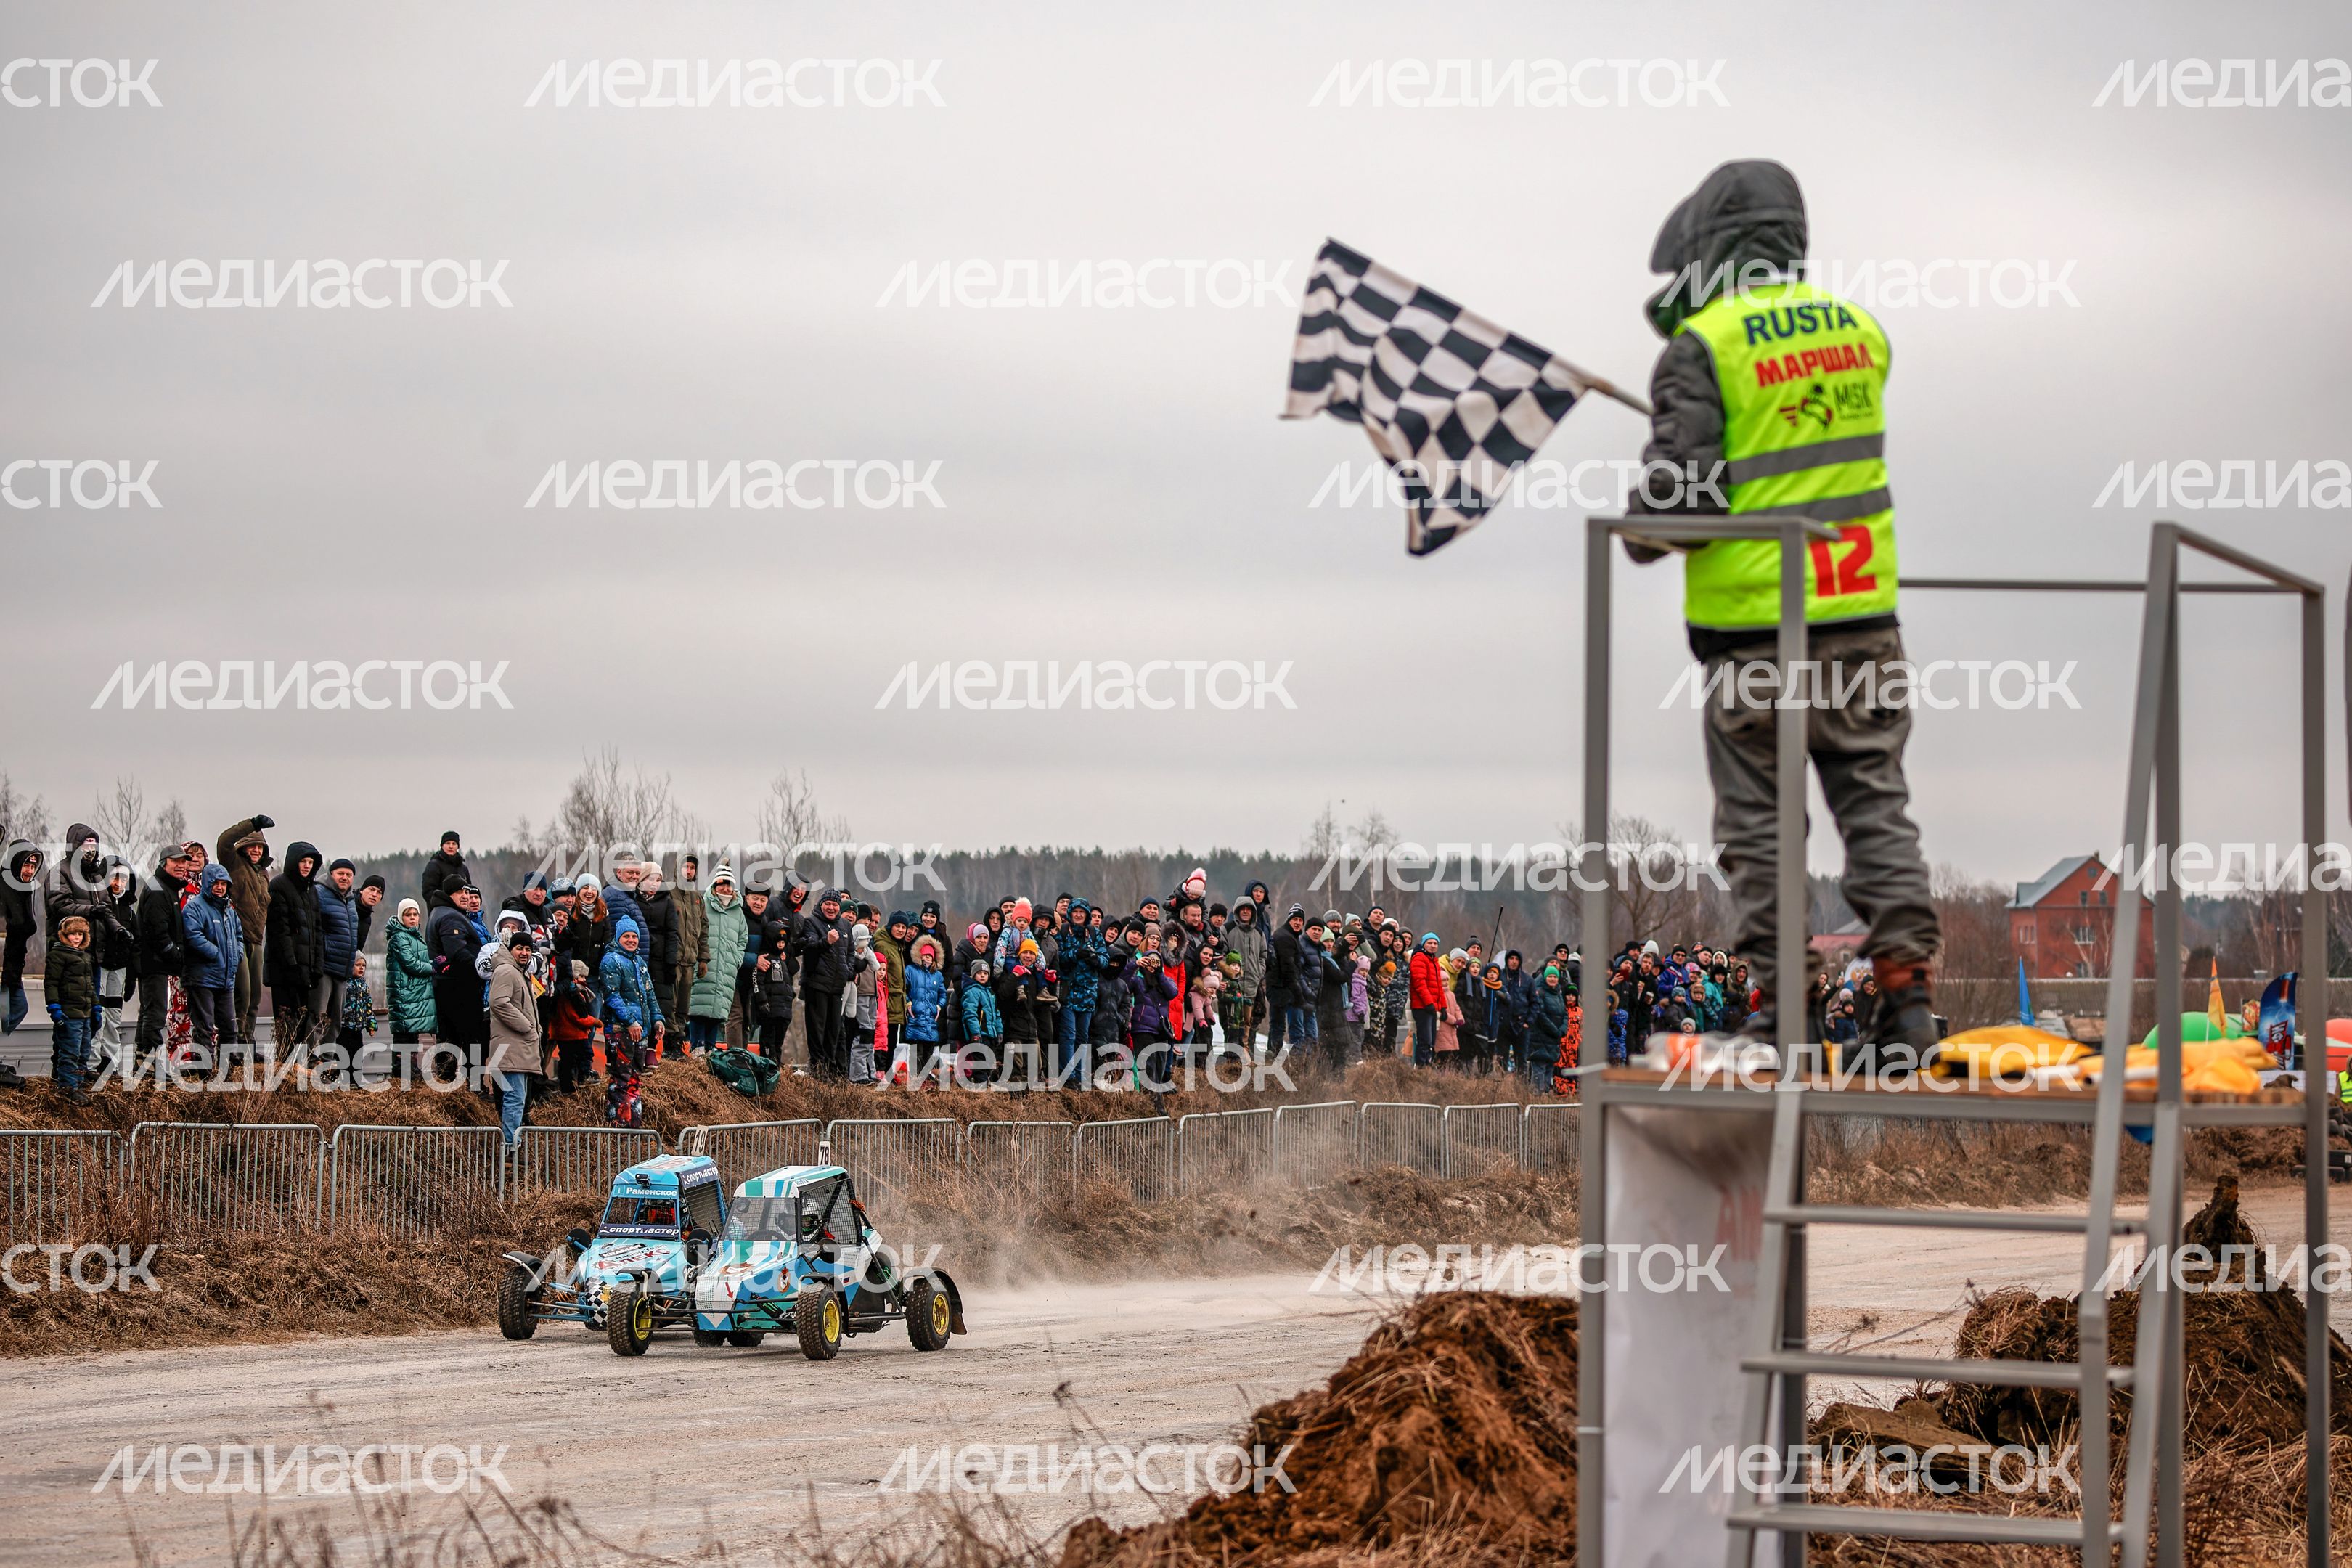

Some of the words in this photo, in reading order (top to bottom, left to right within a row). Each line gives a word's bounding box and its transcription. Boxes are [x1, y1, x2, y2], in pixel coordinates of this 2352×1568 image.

[1742, 301, 1859, 347] RUSTA
[1754, 342, 1875, 388] МАРШАЛ
[1809, 524, 1877, 597] 12
[694, 1130, 706, 1155] 19
[820, 1145, 830, 1166] 78
[626, 1187, 677, 1197] Раменское
